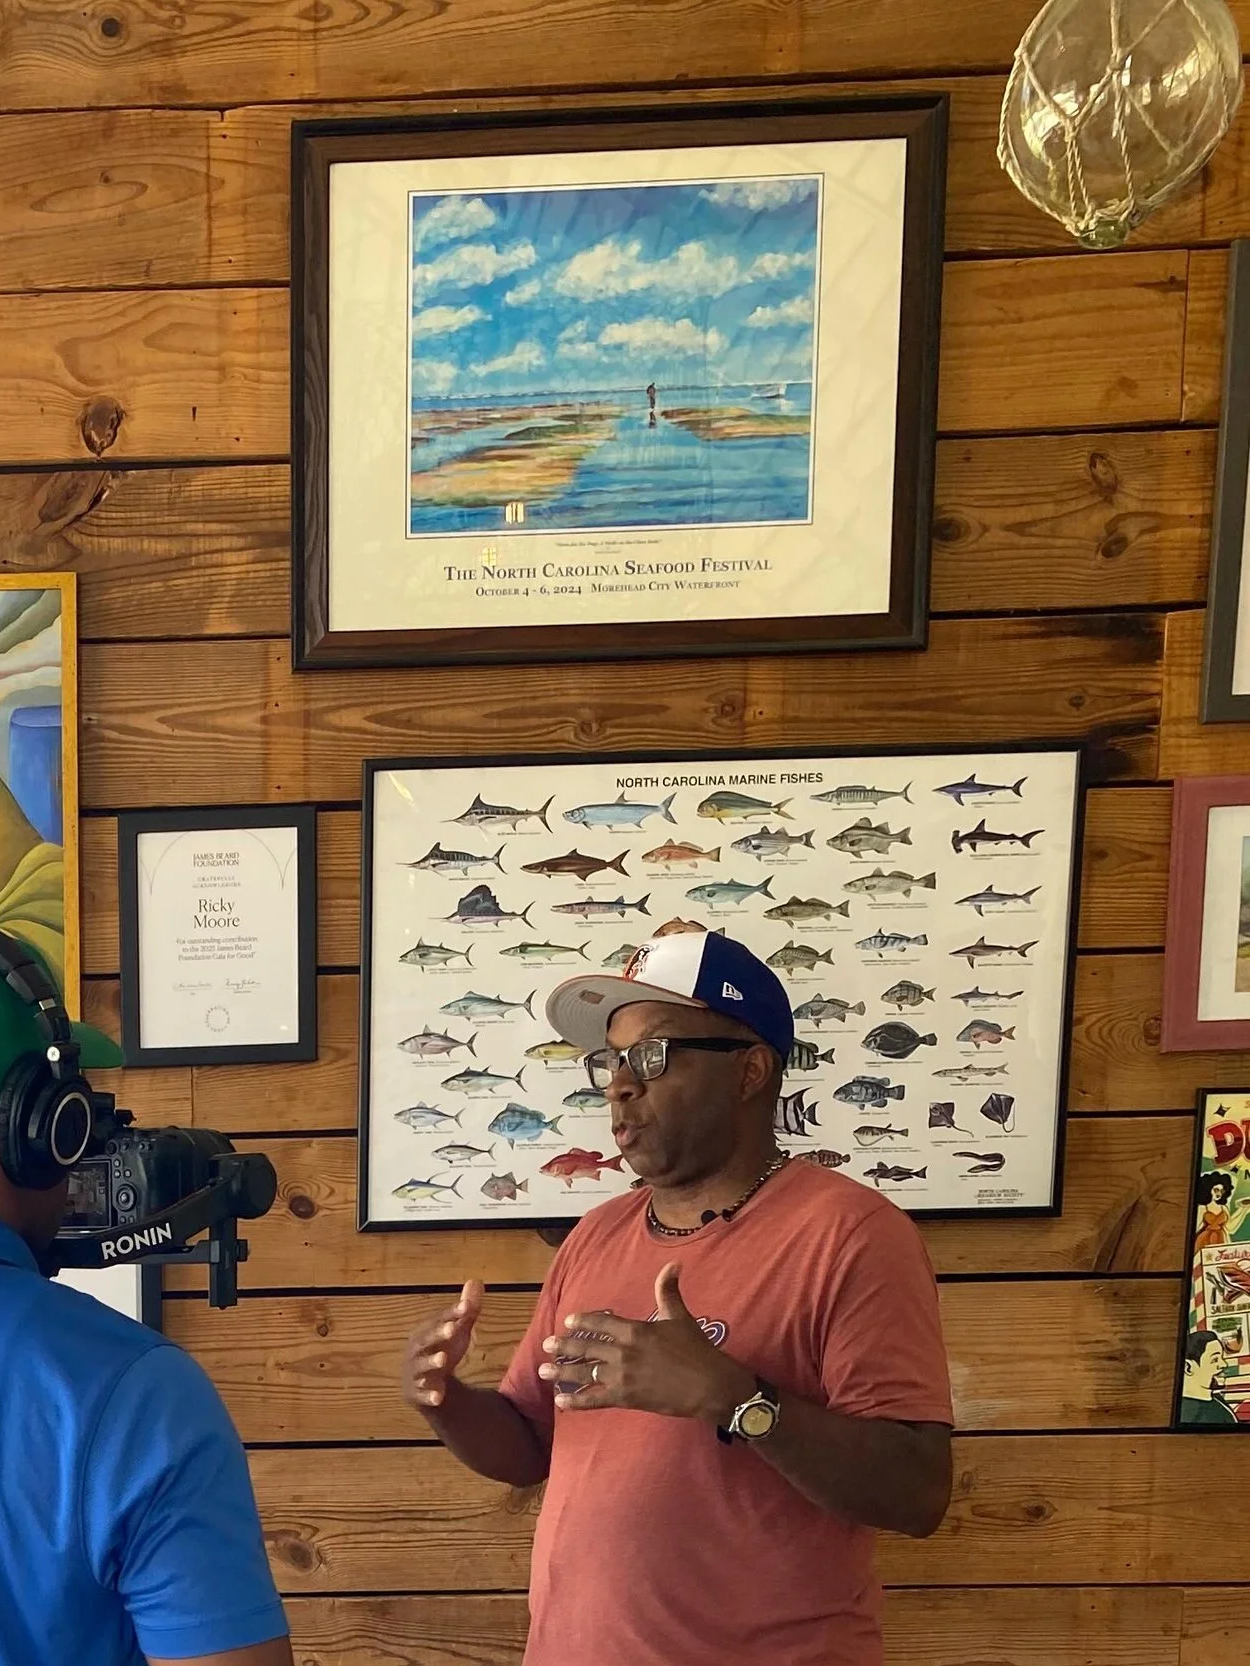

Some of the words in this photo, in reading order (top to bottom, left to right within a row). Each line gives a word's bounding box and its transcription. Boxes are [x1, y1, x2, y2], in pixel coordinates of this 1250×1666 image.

[444, 566, 477, 581] THE
[481, 565, 537, 580] NORTH
[542, 563, 619, 578] CAROLINA
[624, 559, 695, 576] SEAFOOD
[701, 557, 773, 573] FESTIVAL
[475, 586, 520, 596] OCTOBER
[522, 587, 529, 597] 4
[553, 586, 582, 595] 2024
[591, 583, 646, 593] MOREHEAD
[649, 581, 672, 591] CITY
[674, 580, 741, 591] WATERFRONT
[616, 777, 658, 788] NORTH
[662, 775, 725, 787] CAROLINA
[729, 774, 776, 785] MARINE
[780, 772, 824, 784] FISHES
[198, 897, 235, 915] Ricky
[193, 915, 240, 929] Moore
[1206, 1119, 1250, 1167] D
[101, 1222, 172, 1260] RONIN
